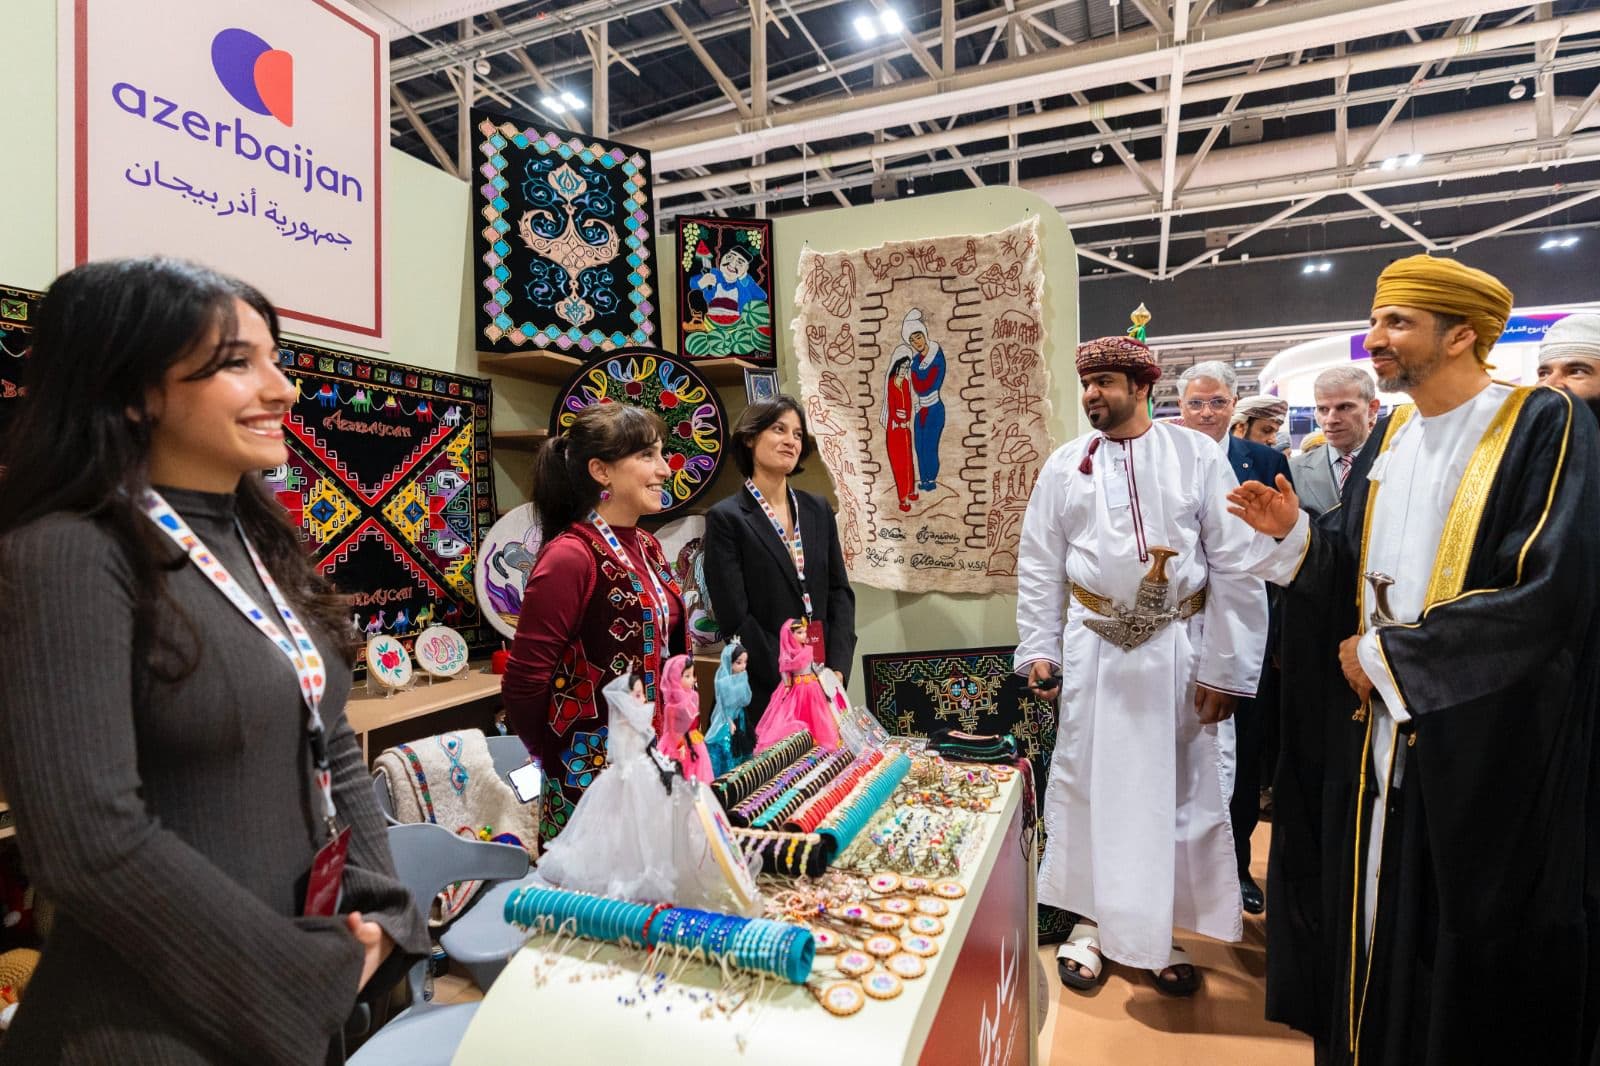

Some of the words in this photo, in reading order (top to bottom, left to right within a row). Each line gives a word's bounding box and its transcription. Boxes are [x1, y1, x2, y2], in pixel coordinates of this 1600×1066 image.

[112, 82, 362, 202] azerbaijan
[125, 160, 257, 216] أذربيجان
[264, 200, 353, 251] جمهورية
